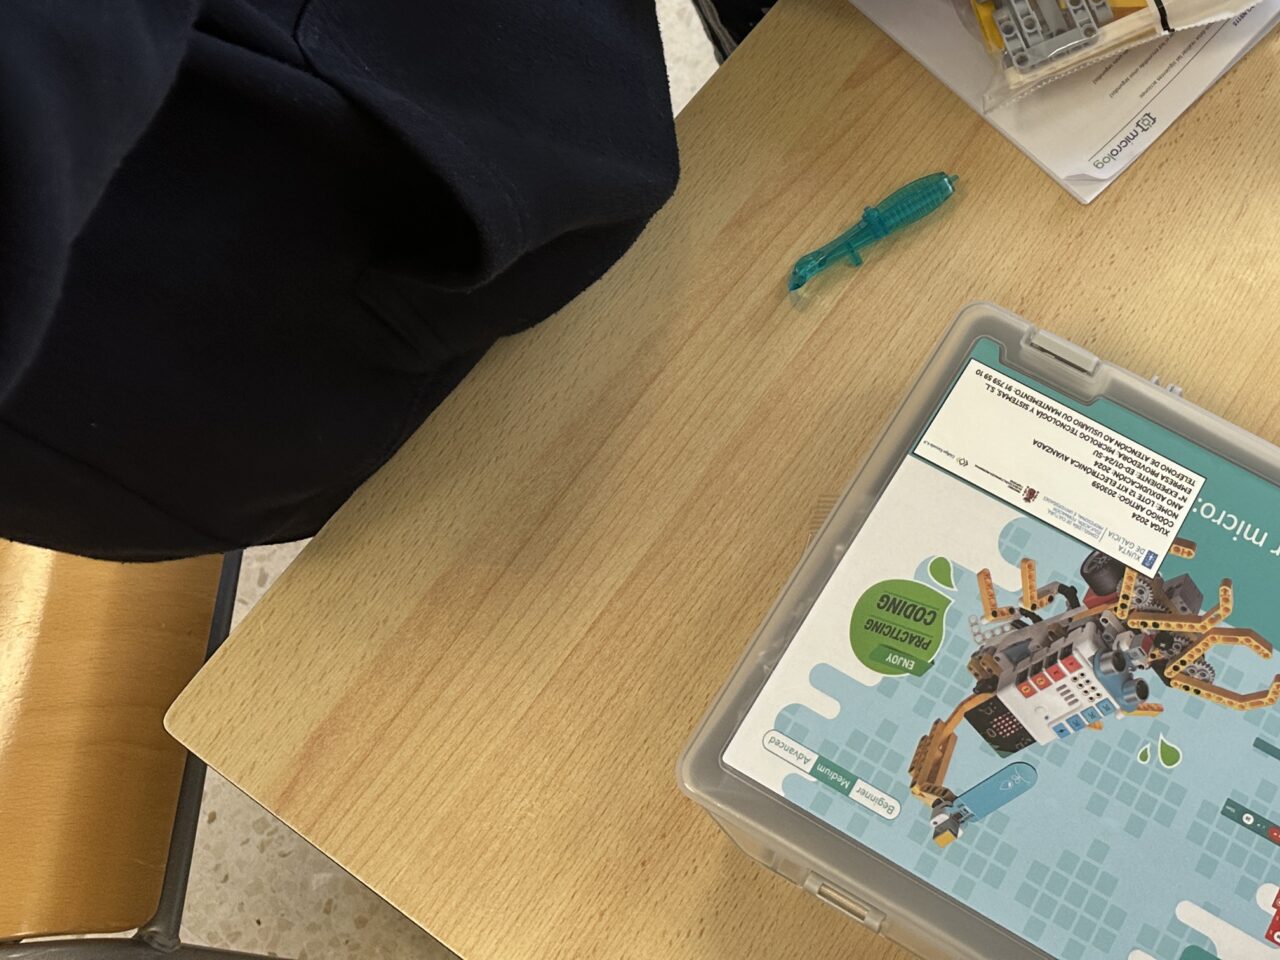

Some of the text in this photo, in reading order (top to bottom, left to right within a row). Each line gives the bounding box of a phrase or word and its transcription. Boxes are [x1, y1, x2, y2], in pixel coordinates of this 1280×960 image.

[1092, 128, 1139, 169] microlog
[995, 388, 1030, 410] SISTEMAS,
[974, 368, 1196, 487] TELÉFONO DE ATENCIÓN AO USUARIO OU MANTEMENTO: 91 759 59 10
[1035, 408, 1078, 436] TECNOLOGÍA
[1078, 431, 1116, 455] MICROLOG
[1091, 448, 1135, 475] ED-01/24-SU
[1031, 438, 1179, 519] NOME: LOTE 12 KIT ELECTRÓNICA AVANZADA
[1092, 459, 1184, 510] ANO ADXUDICACIÓN: 2024
[1136, 471, 1179, 497] EXPEDIENTE:
[1159, 473, 1193, 494] EMPRESA
[1090, 479, 1175, 528] CÓDIGO ARTIGO: 203059
[1130, 511, 1170, 536] XUGA 2024
[1106, 530, 1145, 555] DE GALICIA
[1116, 544, 1141, 561] XUNTA
[875, 593, 937, 626] CODING
[863, 618, 931, 650] PRACTICING
[884, 652, 915, 669] ENJOY
[767, 735, 895, 815] Beginner Medium Advanced
